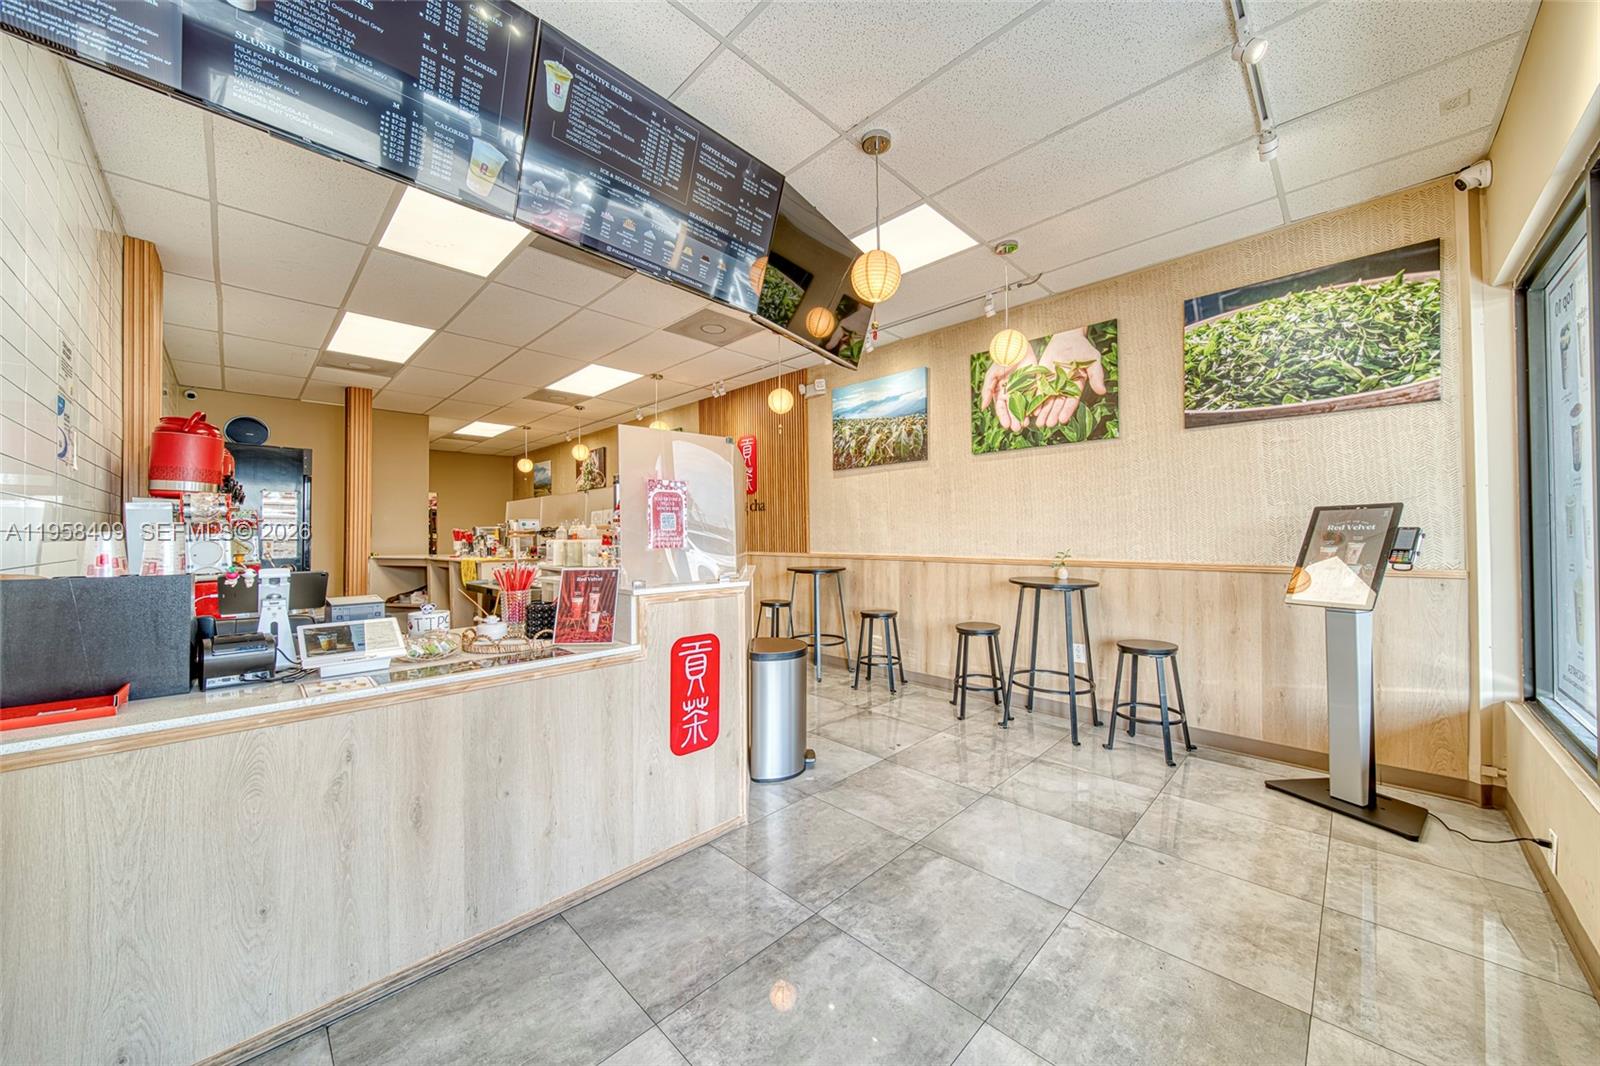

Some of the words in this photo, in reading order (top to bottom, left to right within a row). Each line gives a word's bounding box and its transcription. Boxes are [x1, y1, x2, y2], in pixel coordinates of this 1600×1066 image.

[134, 24, 159, 37] nutrition
[274, 2, 325, 30] WINTERMELON
[326, 27, 341, 38] MILK
[342, 34, 354, 45] TEA
[274, 8, 320, 34] STRAWBERRY
[322, 32, 338, 43] MILK
[338, 39, 351, 50] TEA
[303, 9, 326, 24] SUGAR
[327, 20, 342, 31] MILK
[343, 28, 356, 39] TEA
[326, 13, 340, 24] TEA
[370, 22, 384, 33] Grey
[234, 30, 276, 55] SLUSH
[278, 50, 319, 74] SERIES
[274, 15, 292, 29] EARL
[293, 25, 311, 37] GREY
[313, 34, 328, 46] MILK
[330, 41, 341, 52] TEA
[343, 47, 360, 60] WITH
[234, 50, 262, 67] LYCHEE
[234, 57, 261, 74] MANGO
[262, 69, 279, 81] MILK
[424, 32, 431, 40] M
[443, 42, 448, 50] L
[464, 54, 498, 77] CALORIES
[234, 44, 251, 55] MILK
[253, 52, 274, 66] FOAM
[275, 61, 298, 76] PEACH
[299, 72, 320, 86] SLUSH
[332, 86, 349, 98] STAR
[350, 93, 369, 106] JELLY
[234, 65, 282, 90] STRAWBERRY
[284, 85, 300, 96] MILK
[575, 63, 610, 89] CREATIVE
[610, 83, 633, 102] SERIES
[392, 102, 400, 110] M
[434, 121, 469, 141] CALORIES
[701, 142, 721, 158] COFFEE
[696, 172, 706, 183] TEA
[706, 178, 722, 191] LATTE
[689, 211, 714, 228] SEASONAL
[750, 499, 766, 512] cha
[1347, 523, 1377, 531] Velvet
[678, 640, 713, 748] 貢茶
